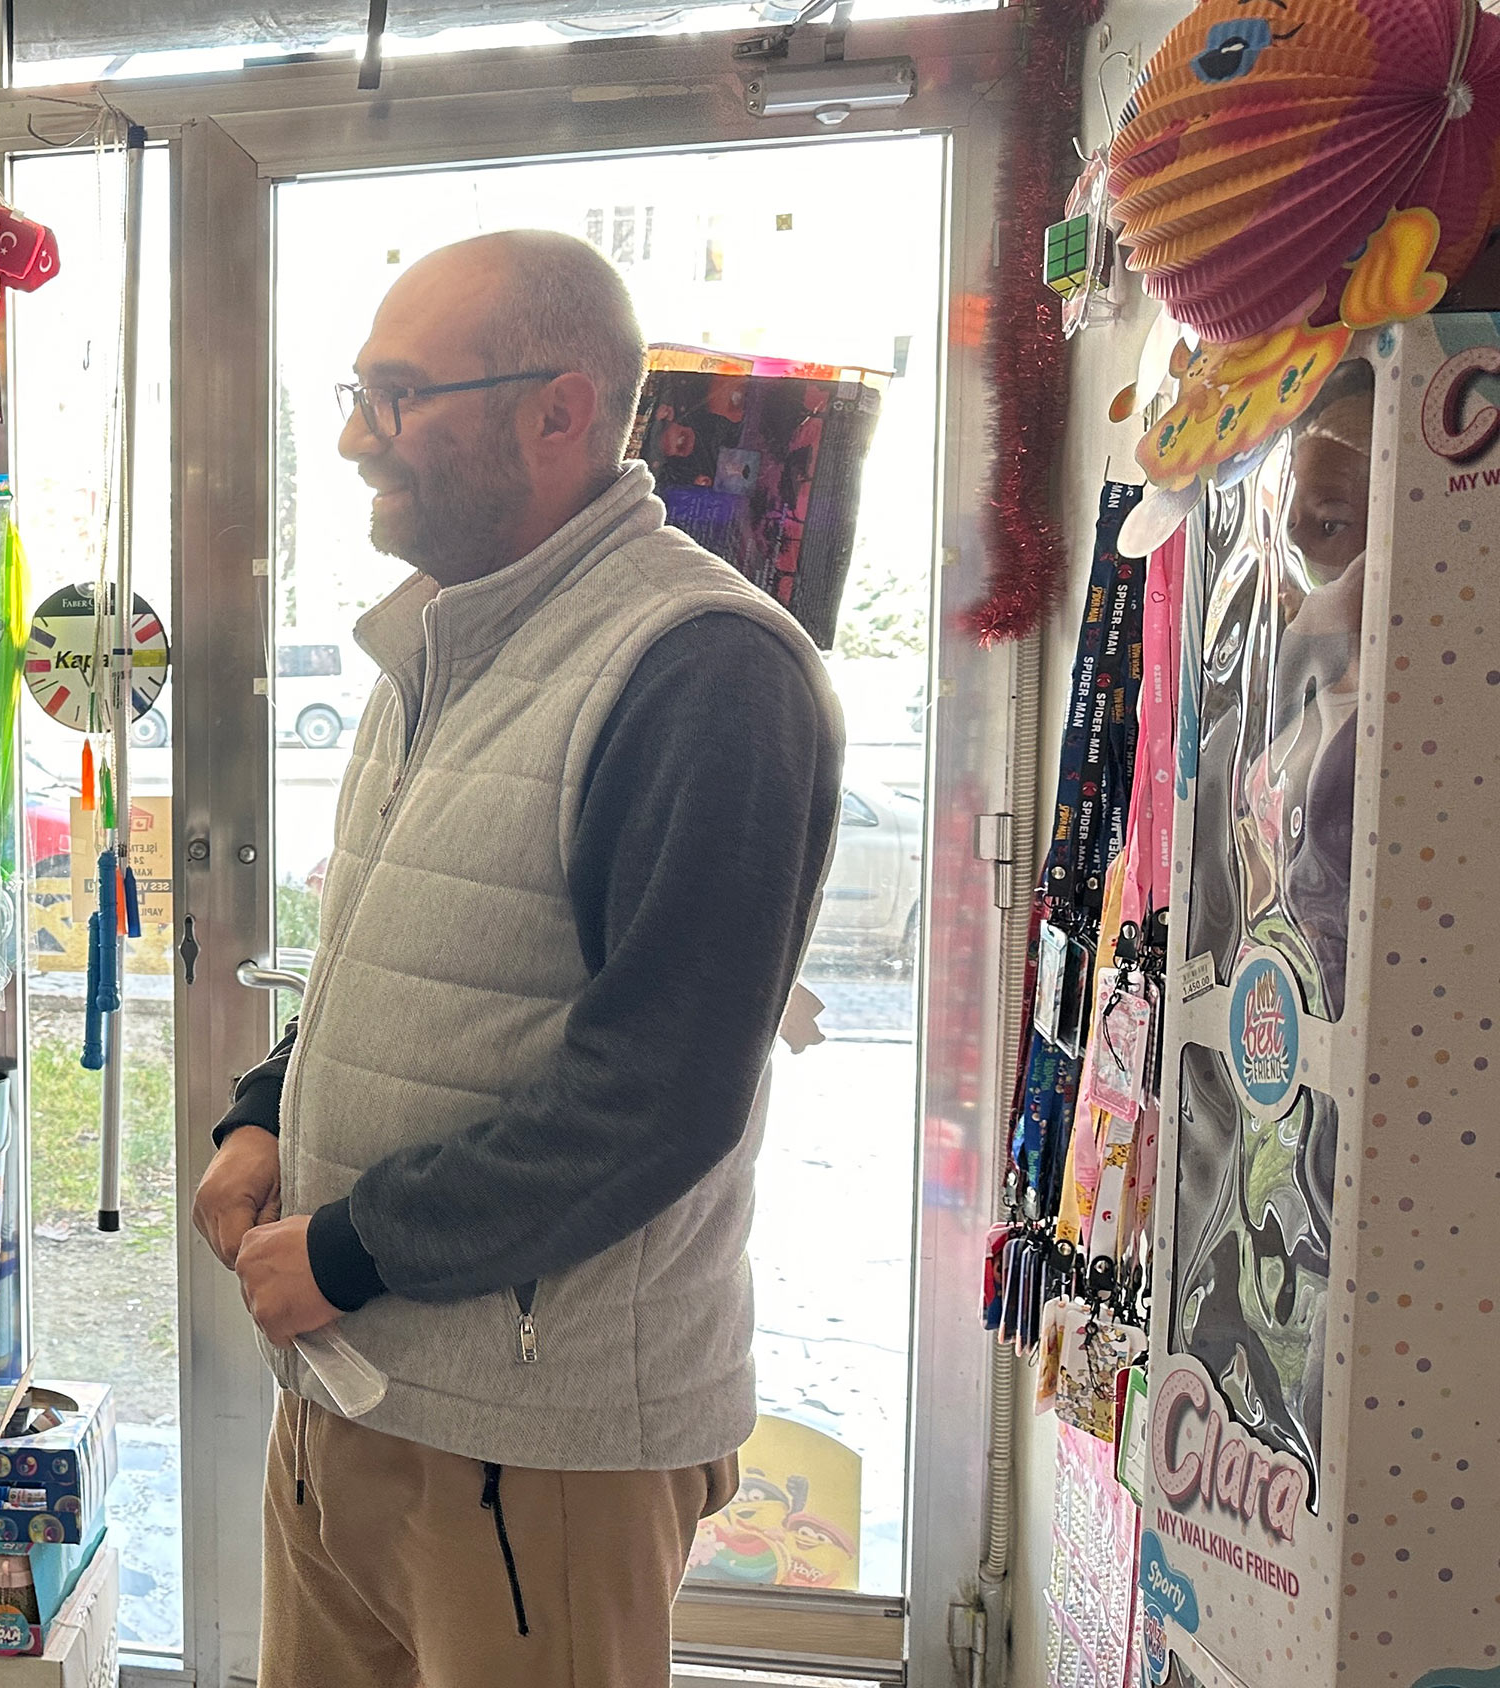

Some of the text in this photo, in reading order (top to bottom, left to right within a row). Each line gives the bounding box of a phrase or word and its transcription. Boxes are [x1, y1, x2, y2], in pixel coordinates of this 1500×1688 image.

[1449, 474, 1478, 492] MY
[1105, 584, 1128, 656] SPIDER-MAN
[1072, 656, 1094, 728] SPIDER-MAN
[1087, 692, 1106, 764] SPIDER-MAN
[1077, 800, 1093, 870] SPIDER-MAN
[1182, 975, 1211, 995] 1.450.00
[1242, 989, 1286, 1058] best
[1252, 1059, 1283, 1082] FRIEND
[1152, 1368, 1303, 1541] Clara
[1148, 1560, 1186, 1612] Sporty
[1157, 1507, 1300, 1597] MY WALKING FRIEND
